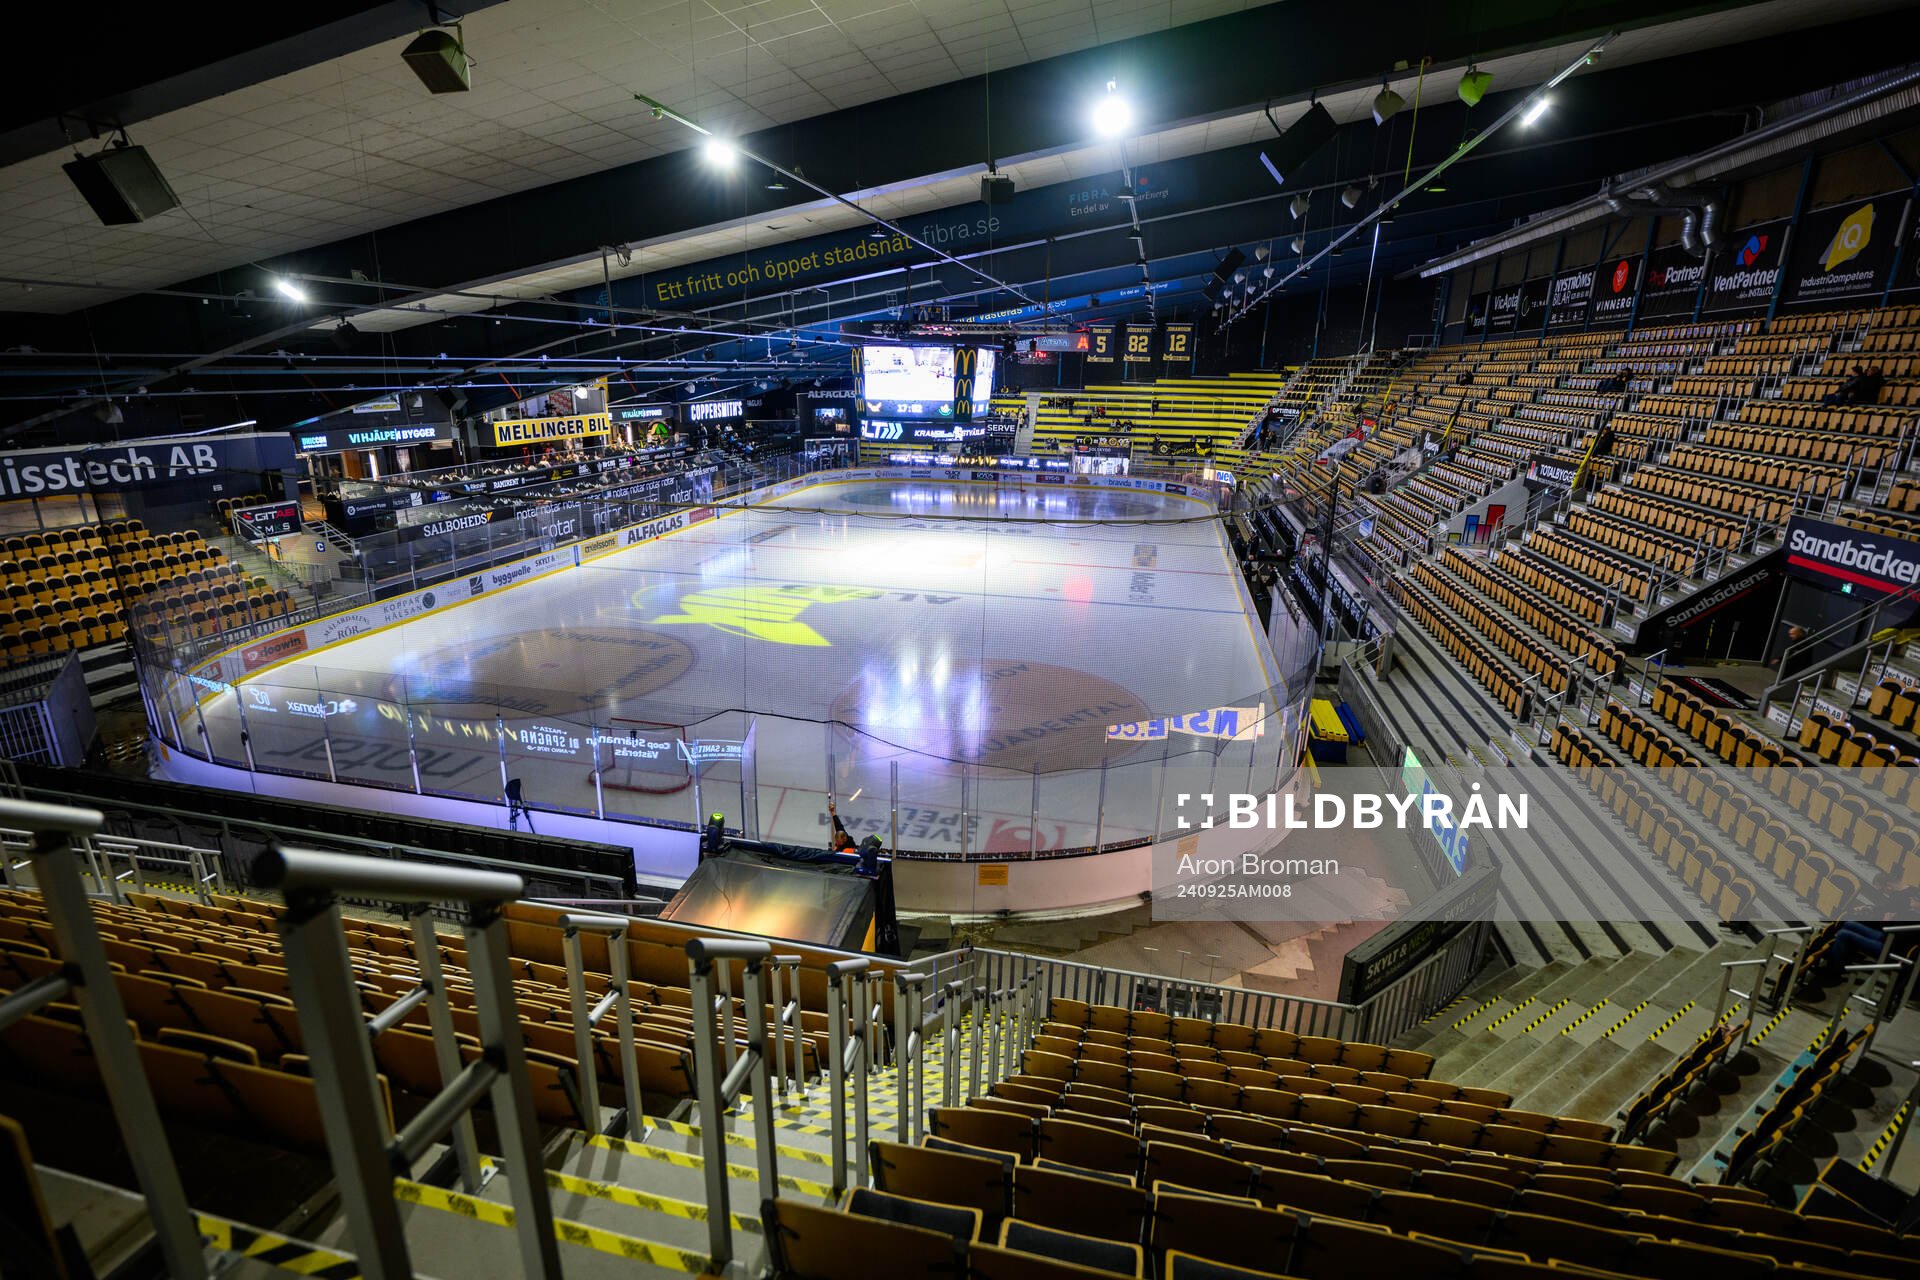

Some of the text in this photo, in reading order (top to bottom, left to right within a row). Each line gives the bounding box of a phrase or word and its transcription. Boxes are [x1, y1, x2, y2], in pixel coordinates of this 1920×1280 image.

[657, 215, 1000, 302] Ett fritt och öppet stadsnät fibra.se
[1714, 268, 1779, 293] VentPartner
[1096, 335, 1107, 353] 5
[1128, 335, 1149, 353] 82
[1169, 334, 1187, 352] 12
[808, 390, 855, 399] ALFAGLAS
[690, 401, 743, 421] COPPERSMITH'S
[401, 428, 436, 440] BYGGER
[498, 416, 609, 442] MELLINGER BIL
[987, 424, 1016, 433] SERVE
[169, 445, 218, 478] AB
[613, 477, 675, 499] notar notar notar notar
[423, 512, 487, 538] SALBOHEDS
[627, 515, 683, 545] ALFAGLAS
[337, 624, 360, 641] RÖR
